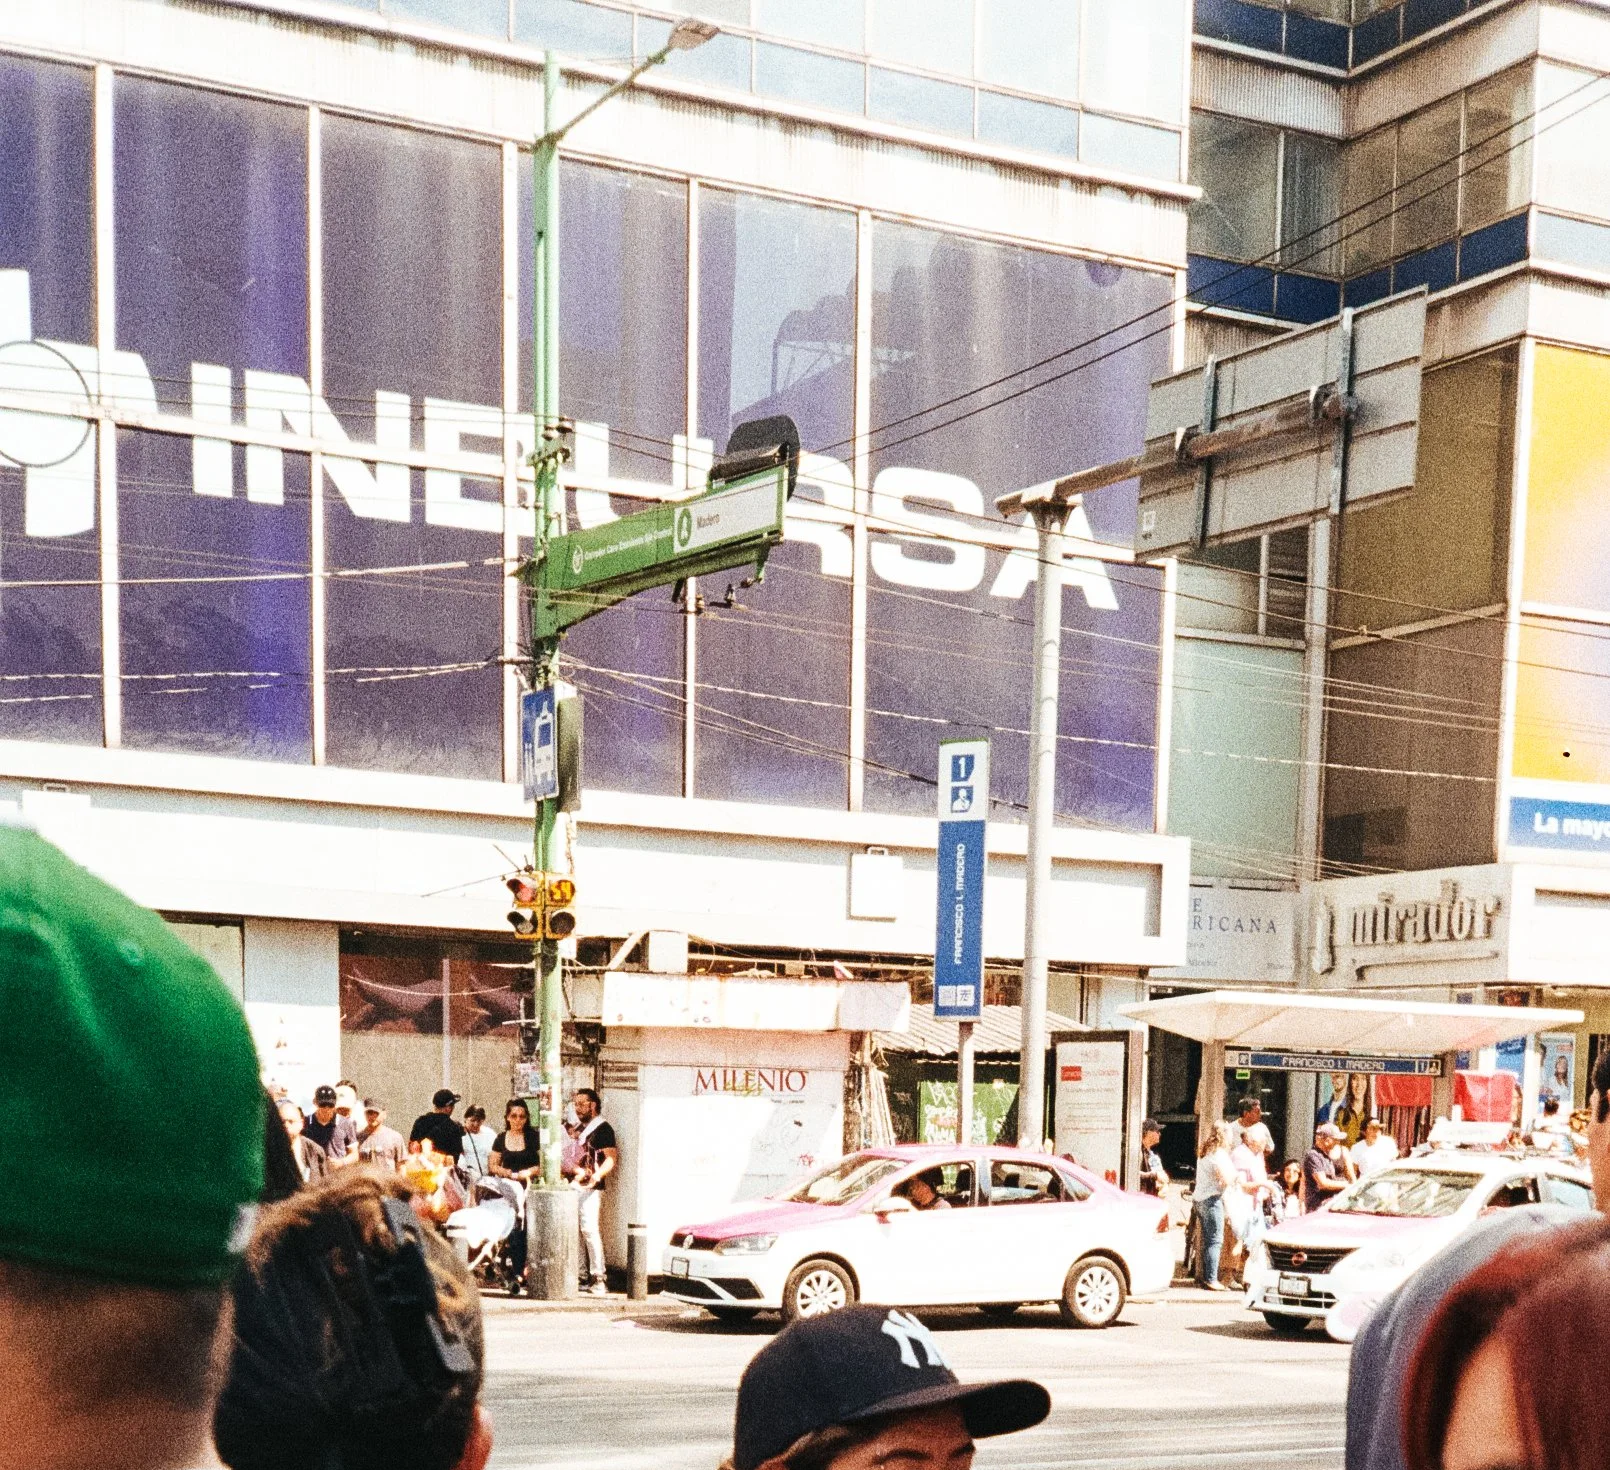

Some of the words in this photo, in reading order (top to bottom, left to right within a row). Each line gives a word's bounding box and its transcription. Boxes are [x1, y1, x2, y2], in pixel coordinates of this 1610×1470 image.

[958, 756, 967, 778] 1
[1534, 812, 1559, 834] La
[955, 843, 966, 890] MADERO
[954, 904, 964, 965] FRANCISCO
[1282, 1056, 1334, 1070] FRANCISCO
[1346, 1059, 1386, 1072] MADERO
[695, 1069, 807, 1092] MILENIO
